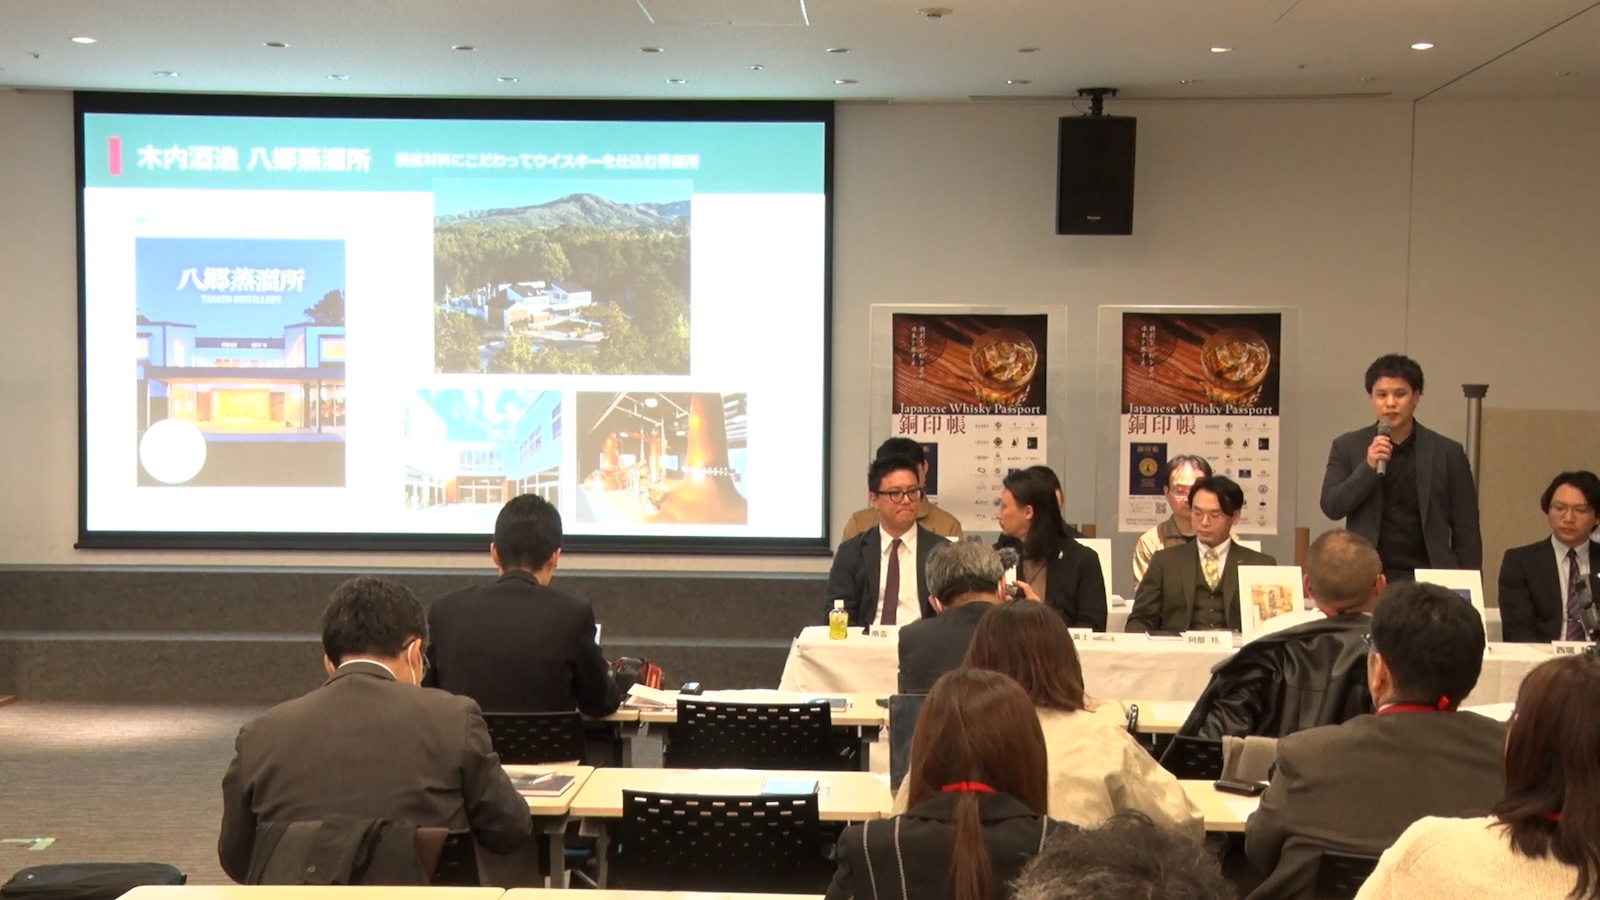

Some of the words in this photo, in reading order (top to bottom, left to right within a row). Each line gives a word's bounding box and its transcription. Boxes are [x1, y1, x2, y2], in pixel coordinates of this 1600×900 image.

[137, 145, 239, 171] 木内酒造
[899, 402, 947, 416] Japanese
[949, 403, 993, 416] Whisky
[994, 403, 1041, 417] Passport
[1128, 402, 1177, 416] Japanese
[1179, 403, 1223, 416] Whisky
[1225, 404, 1273, 417] Passport
[899, 415, 966, 435] 銅印帳
[1127, 415, 1196, 435] 銅印帳
